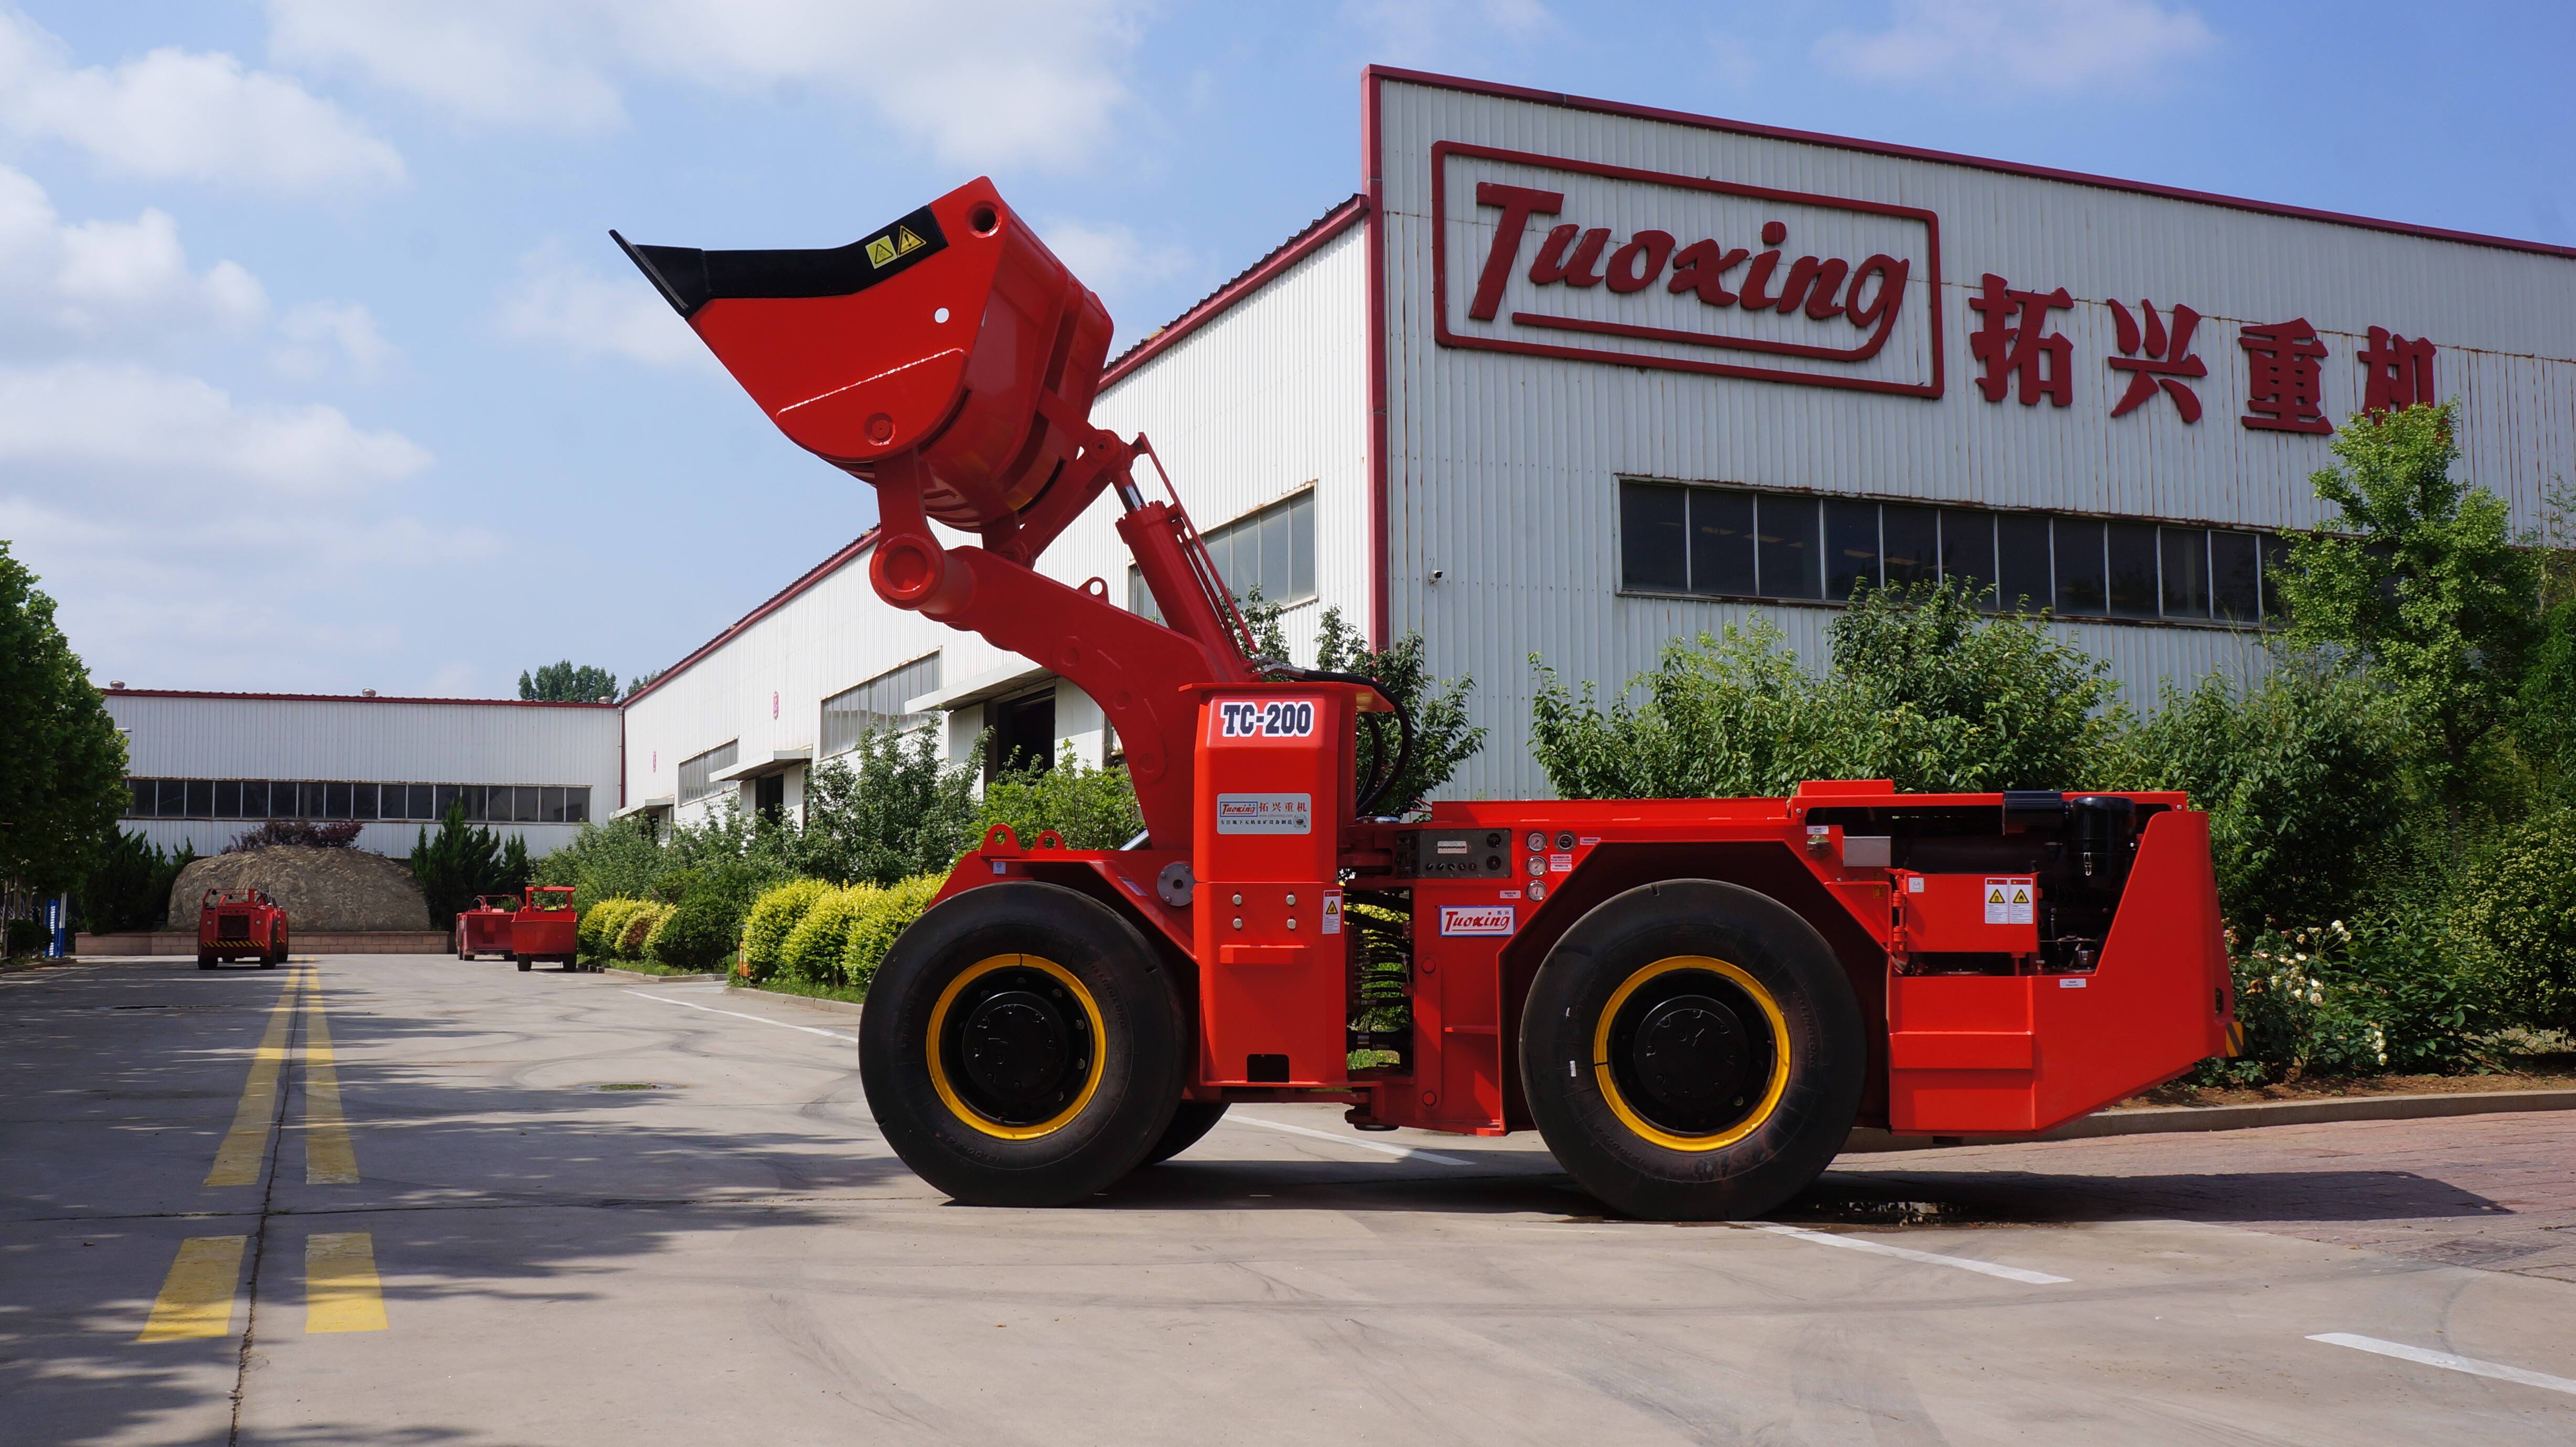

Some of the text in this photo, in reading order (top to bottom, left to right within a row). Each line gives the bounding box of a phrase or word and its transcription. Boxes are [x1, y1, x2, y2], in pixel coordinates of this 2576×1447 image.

[1469, 181, 1909, 361] Tuoxing
[1223, 704, 1311, 734] TC-200
[1222, 804, 1255, 815] Tuoxing
[1259, 802, 1307, 812] 拓兴重机
[1445, 911, 1510, 932] Tuoxing
